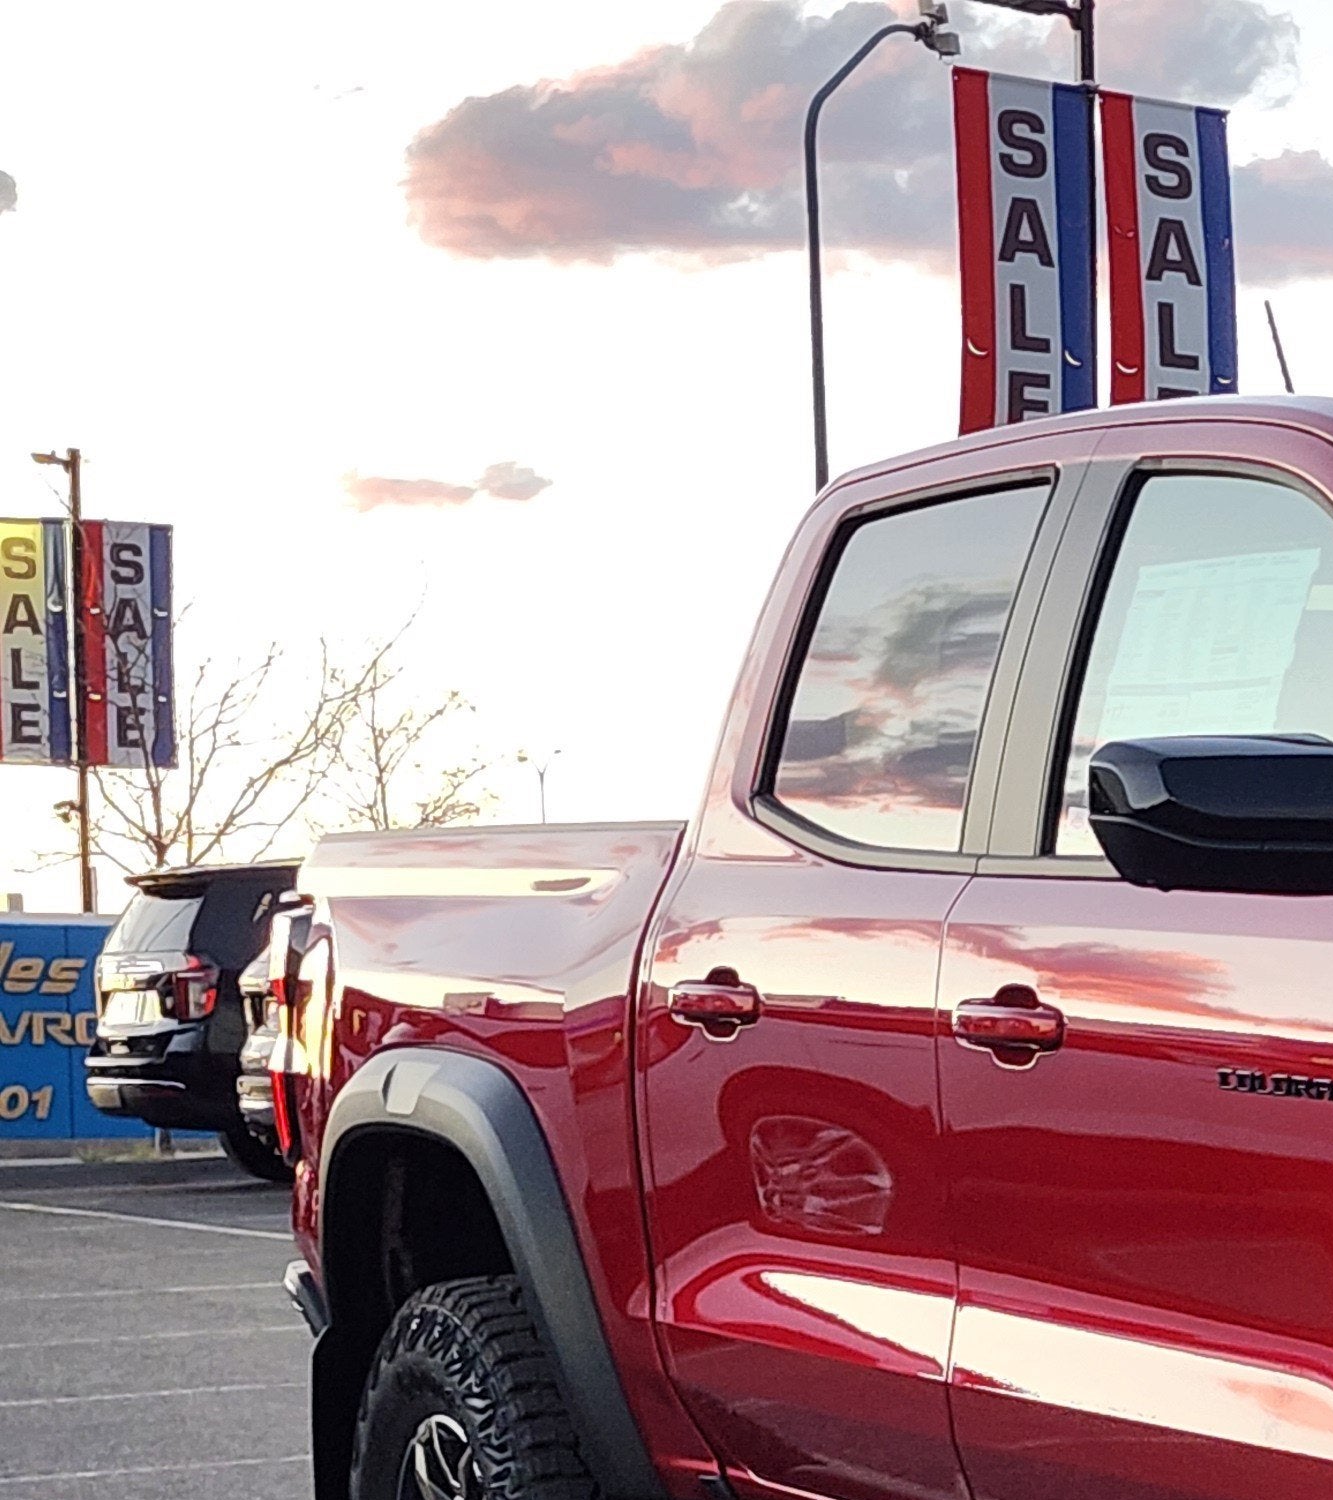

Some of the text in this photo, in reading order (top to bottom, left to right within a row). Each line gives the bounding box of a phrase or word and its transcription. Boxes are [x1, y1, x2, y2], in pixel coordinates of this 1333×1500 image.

[1142, 132, 1203, 401] SAL
[0, 536, 43, 744] SALE
[105, 542, 147, 748] SALE
